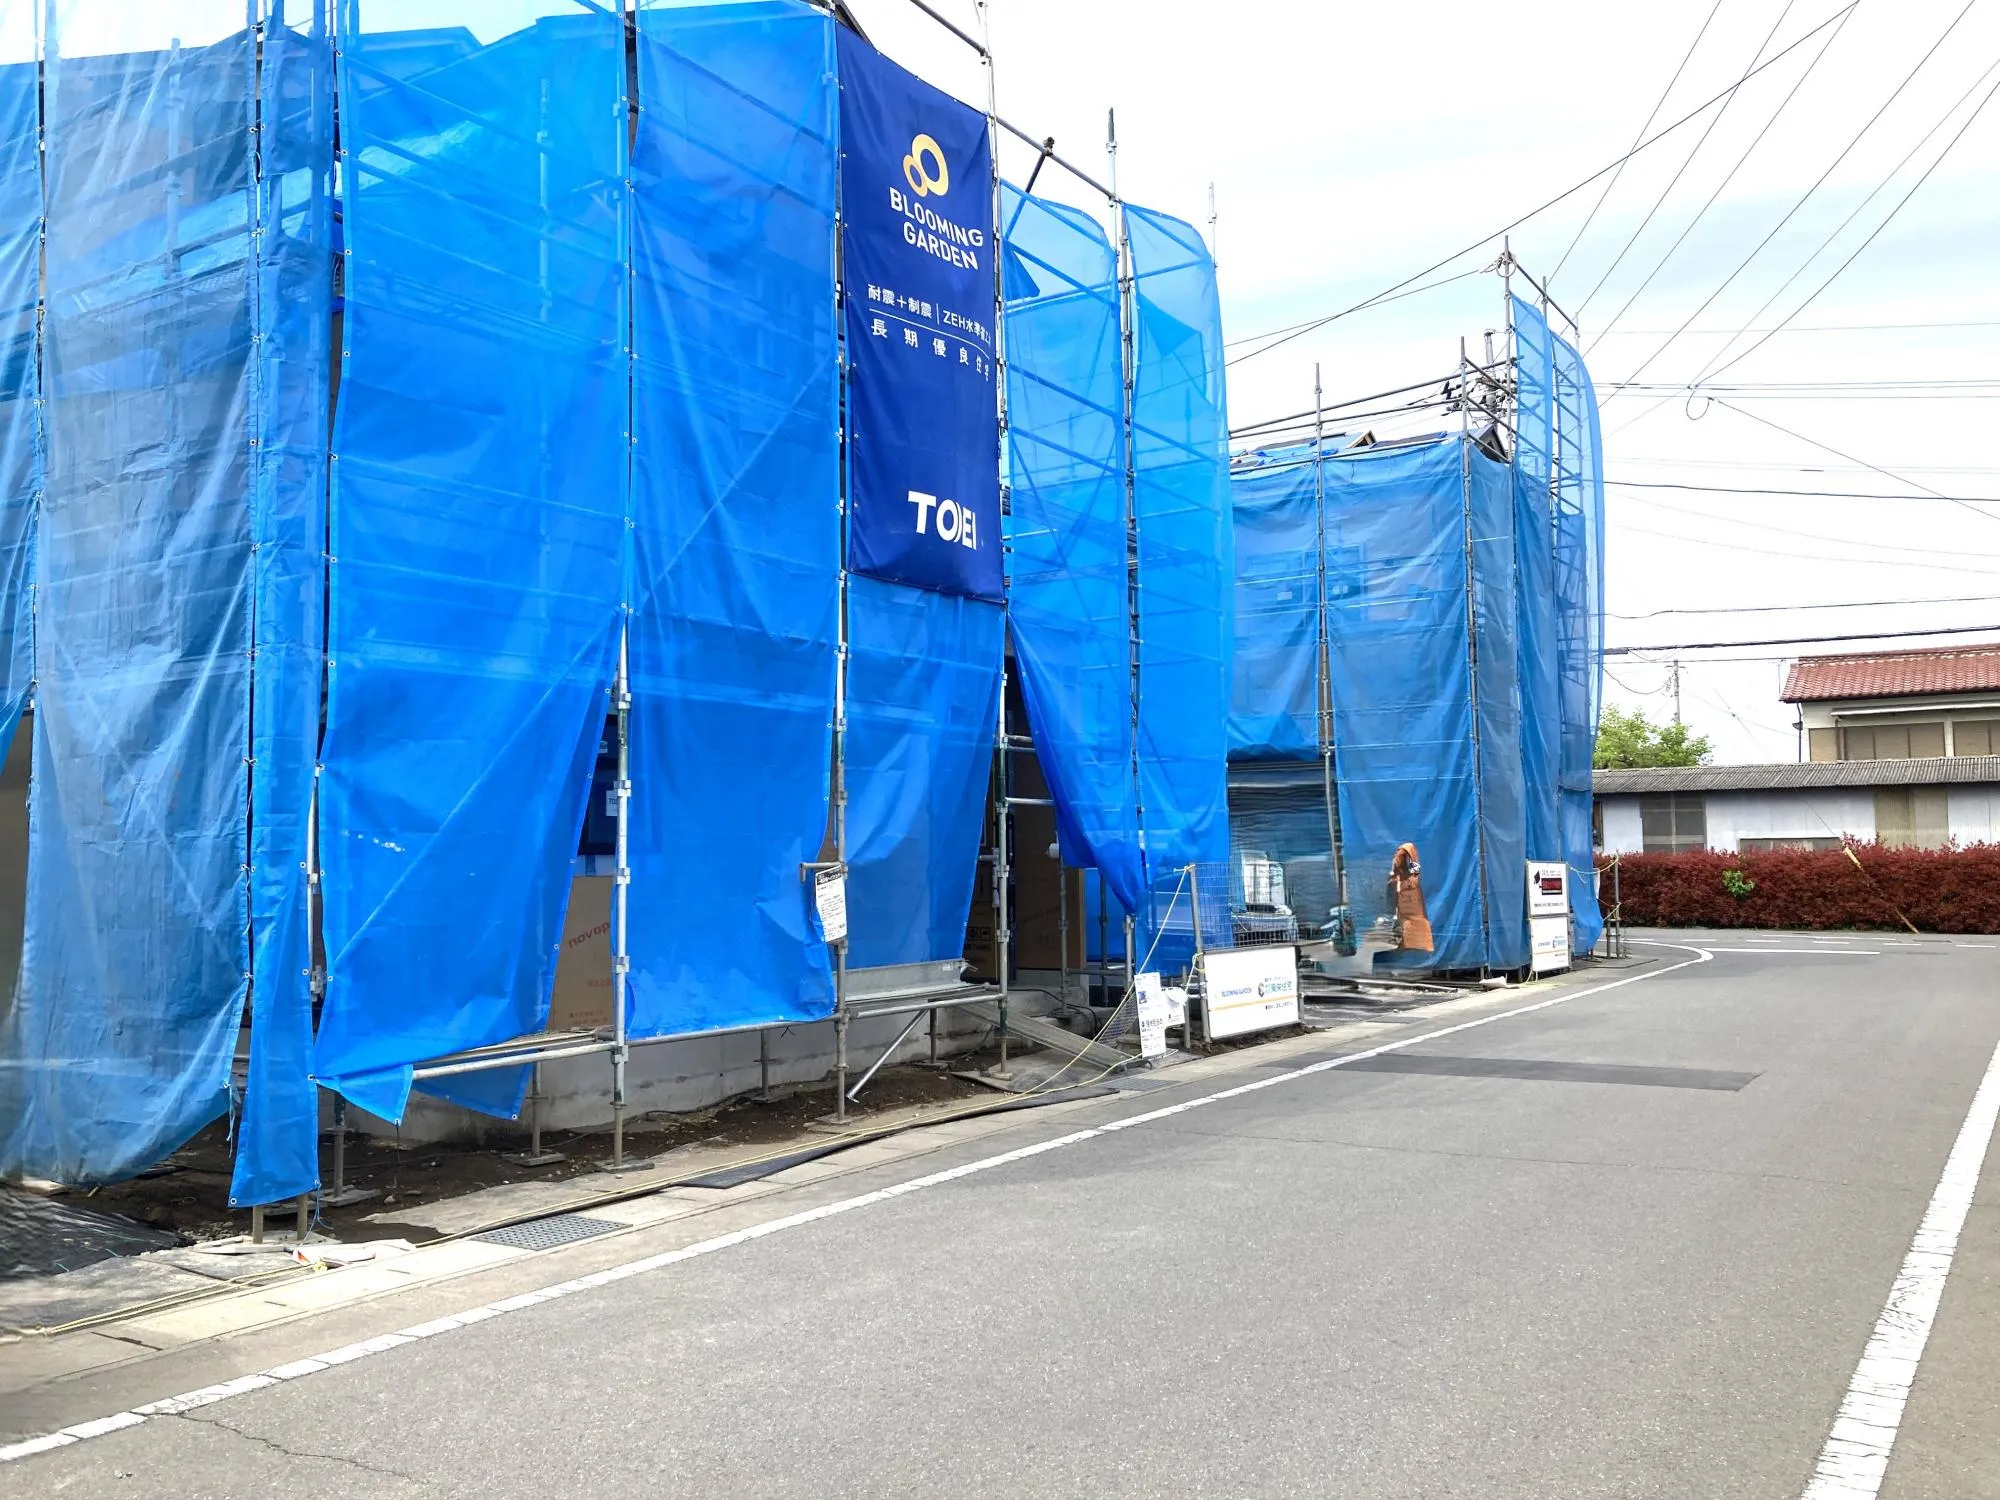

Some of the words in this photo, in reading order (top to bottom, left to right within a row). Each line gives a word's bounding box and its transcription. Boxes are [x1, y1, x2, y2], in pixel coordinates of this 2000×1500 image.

[889, 186, 984, 247] BLOOMING
[903, 221, 979, 270] GARDEN
[908, 490, 977, 550] TOEI
